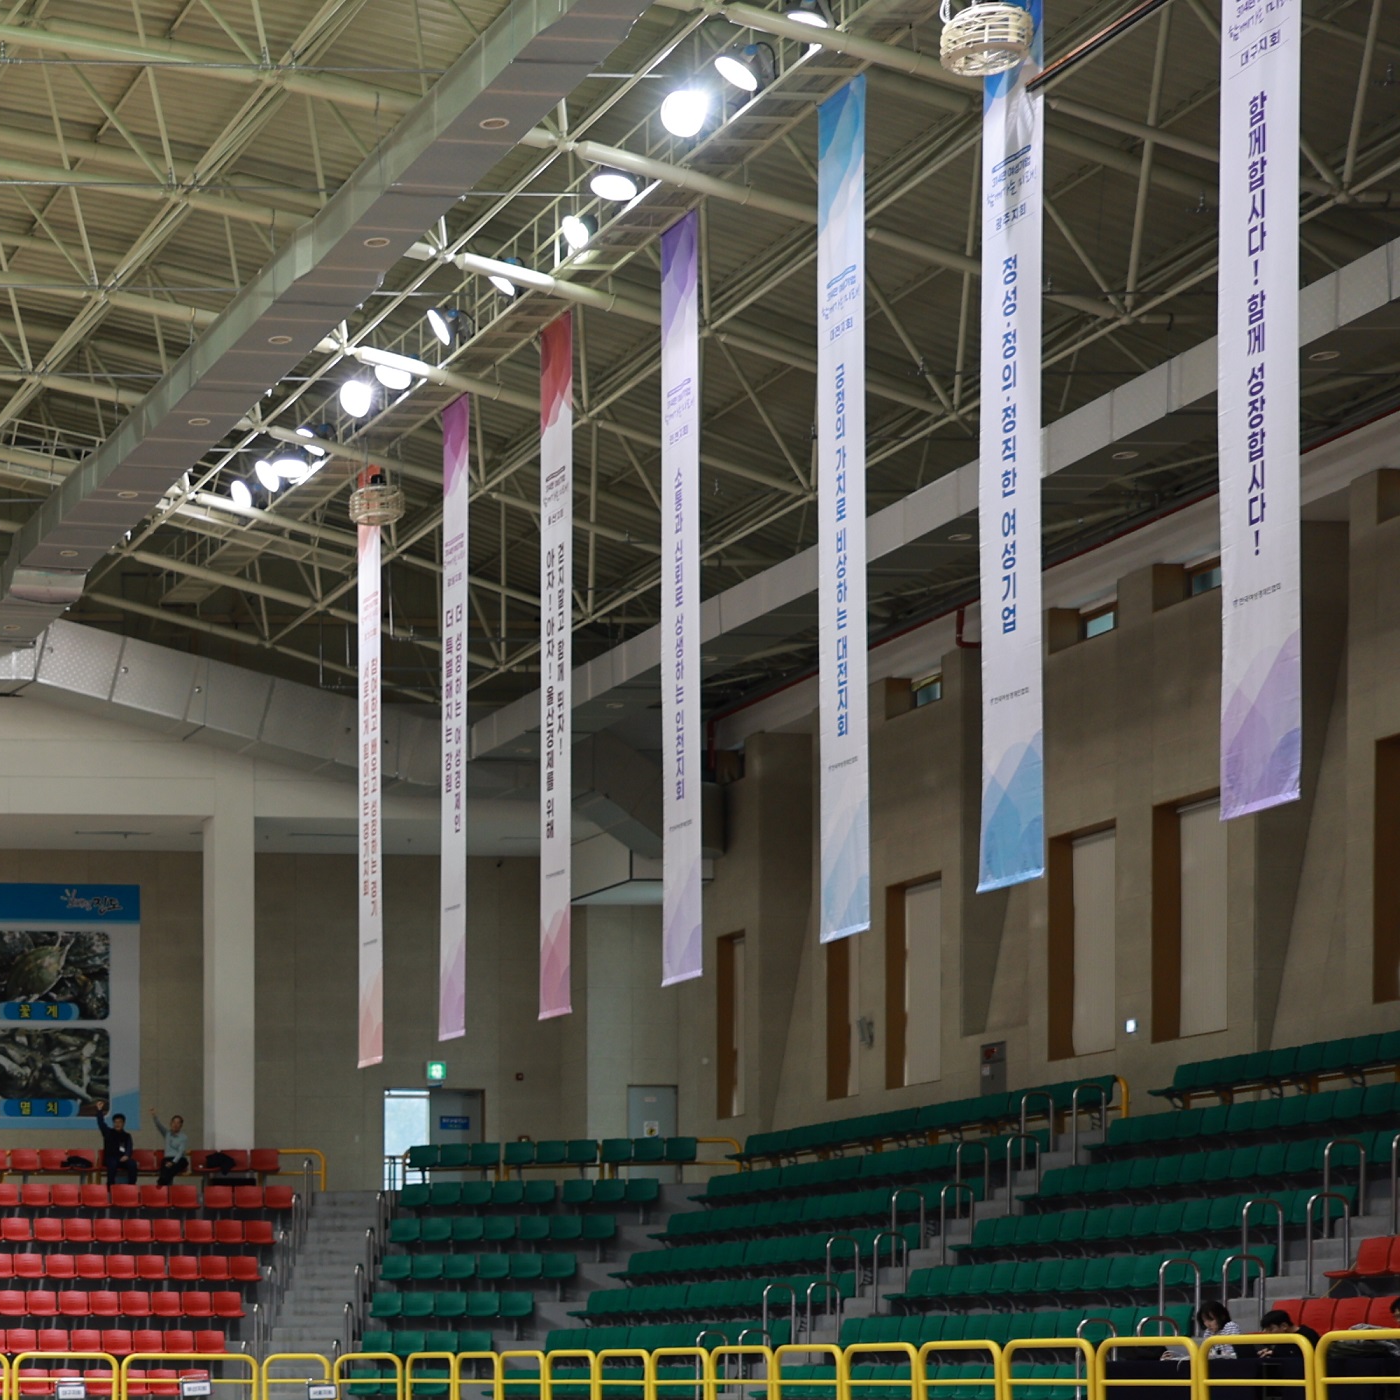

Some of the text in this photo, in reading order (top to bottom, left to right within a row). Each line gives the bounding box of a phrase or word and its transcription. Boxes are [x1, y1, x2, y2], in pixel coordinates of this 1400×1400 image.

[1240, 29, 1280, 67] 대구지회
[1247, 91, 1267, 556] 함께합시다! 함께 성장합시다!
[446, 608, 454, 628] 더
[557, 638, 564, 682] 함께
[674, 467, 685, 801] 소통과 신뢰로 상생하는 인천지회
[835, 362, 848, 737] 긍정의 가치로 비상하는 대전지회
[1001, 509, 1017, 634] 여성기업
[454, 602, 463, 834] 더 성장하는 여성경제인
[546, 548, 555, 840] 아자! 아자! 울산경제를 위해
